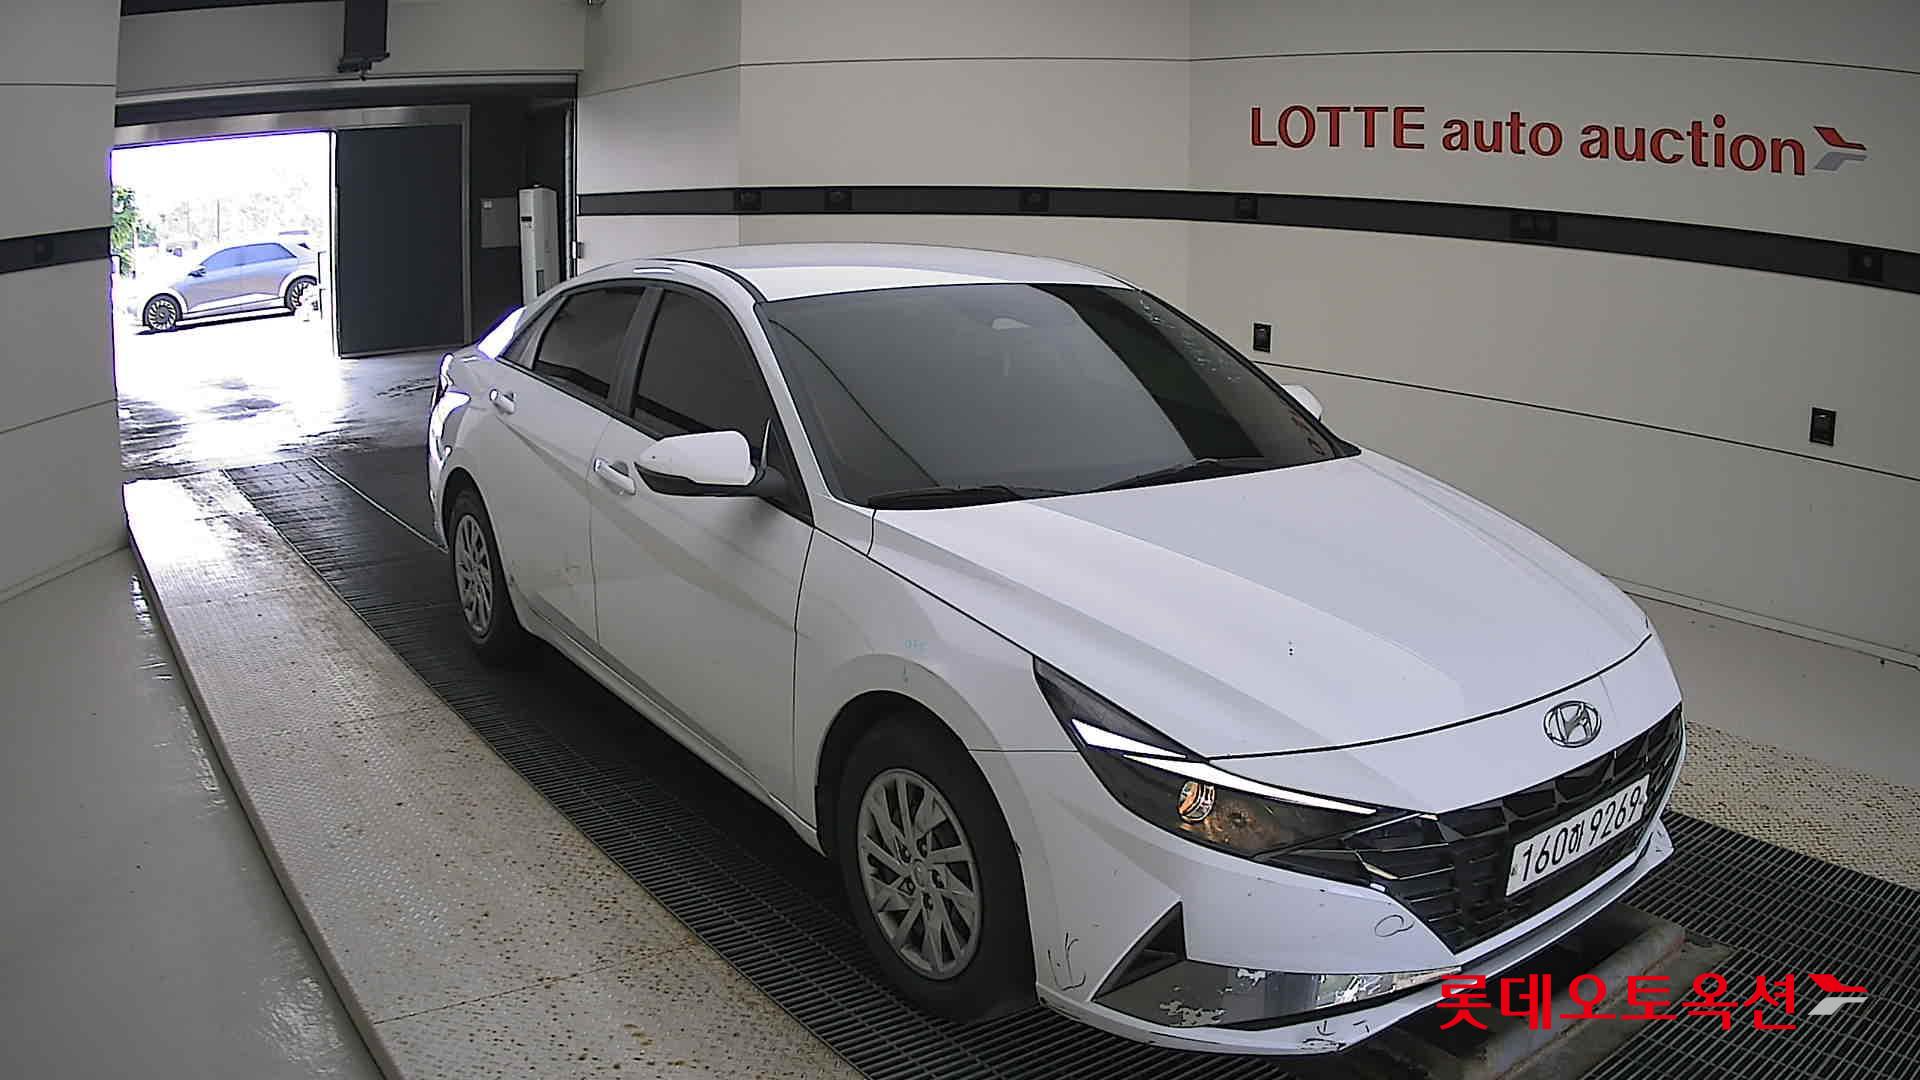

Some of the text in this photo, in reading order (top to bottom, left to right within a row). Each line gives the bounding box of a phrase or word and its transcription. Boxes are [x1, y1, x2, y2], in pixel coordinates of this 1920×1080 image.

[1249, 106, 1805, 176] LOTTE auto auction
[1588, 785, 1642, 846] 9269
